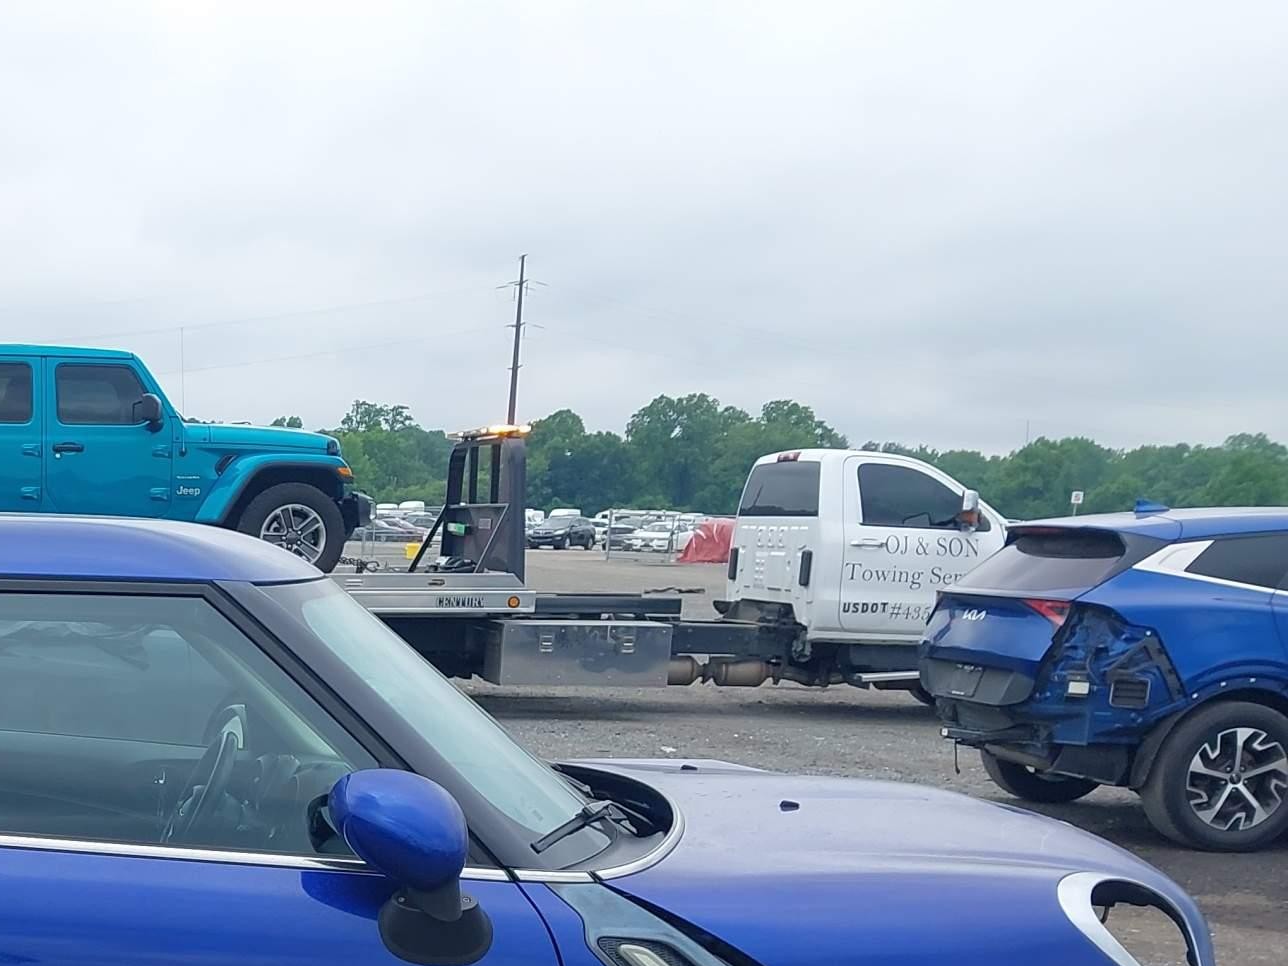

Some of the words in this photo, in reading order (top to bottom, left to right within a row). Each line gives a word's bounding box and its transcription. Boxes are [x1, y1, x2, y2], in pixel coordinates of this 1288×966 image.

[176, 485, 201, 496] Jeep
[885, 535, 908, 555] OJ
[915, 537, 929, 556] &
[936, 537, 980, 558] SON
[845, 562, 924, 590] Towing
[929, 566, 966, 586] Ser
[436, 595, 488, 608] CENTURY
[842, 602, 889, 614] USDOT
